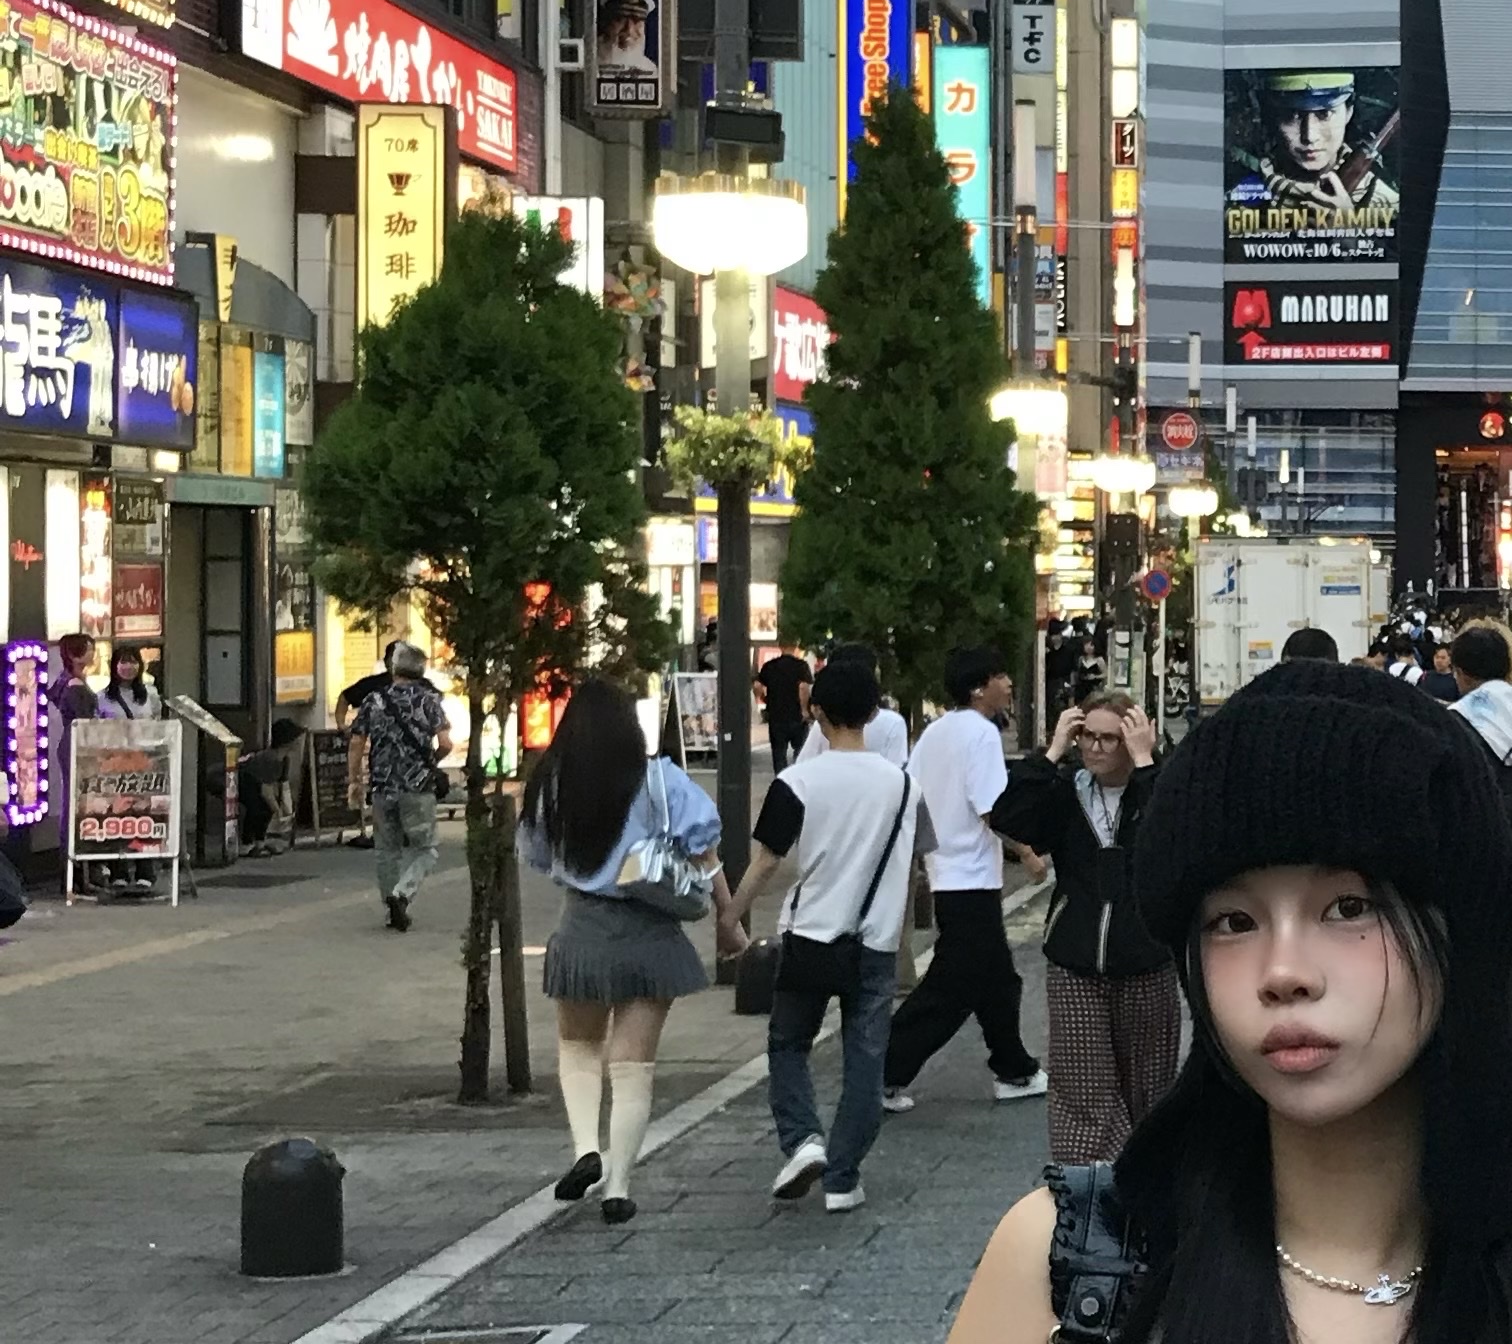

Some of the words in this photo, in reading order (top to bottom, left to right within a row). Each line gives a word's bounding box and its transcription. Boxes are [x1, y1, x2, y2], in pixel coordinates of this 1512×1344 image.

[476, 109, 513, 150] SAKAI
[385, 138, 419, 153] 70席
[1228, 209, 1308, 233] GOLDEN
[1316, 208, 1394, 231] KAMUY
[1281, 295, 1388, 322] MARUHAN
[80, 816, 166, 842] 2,980円
